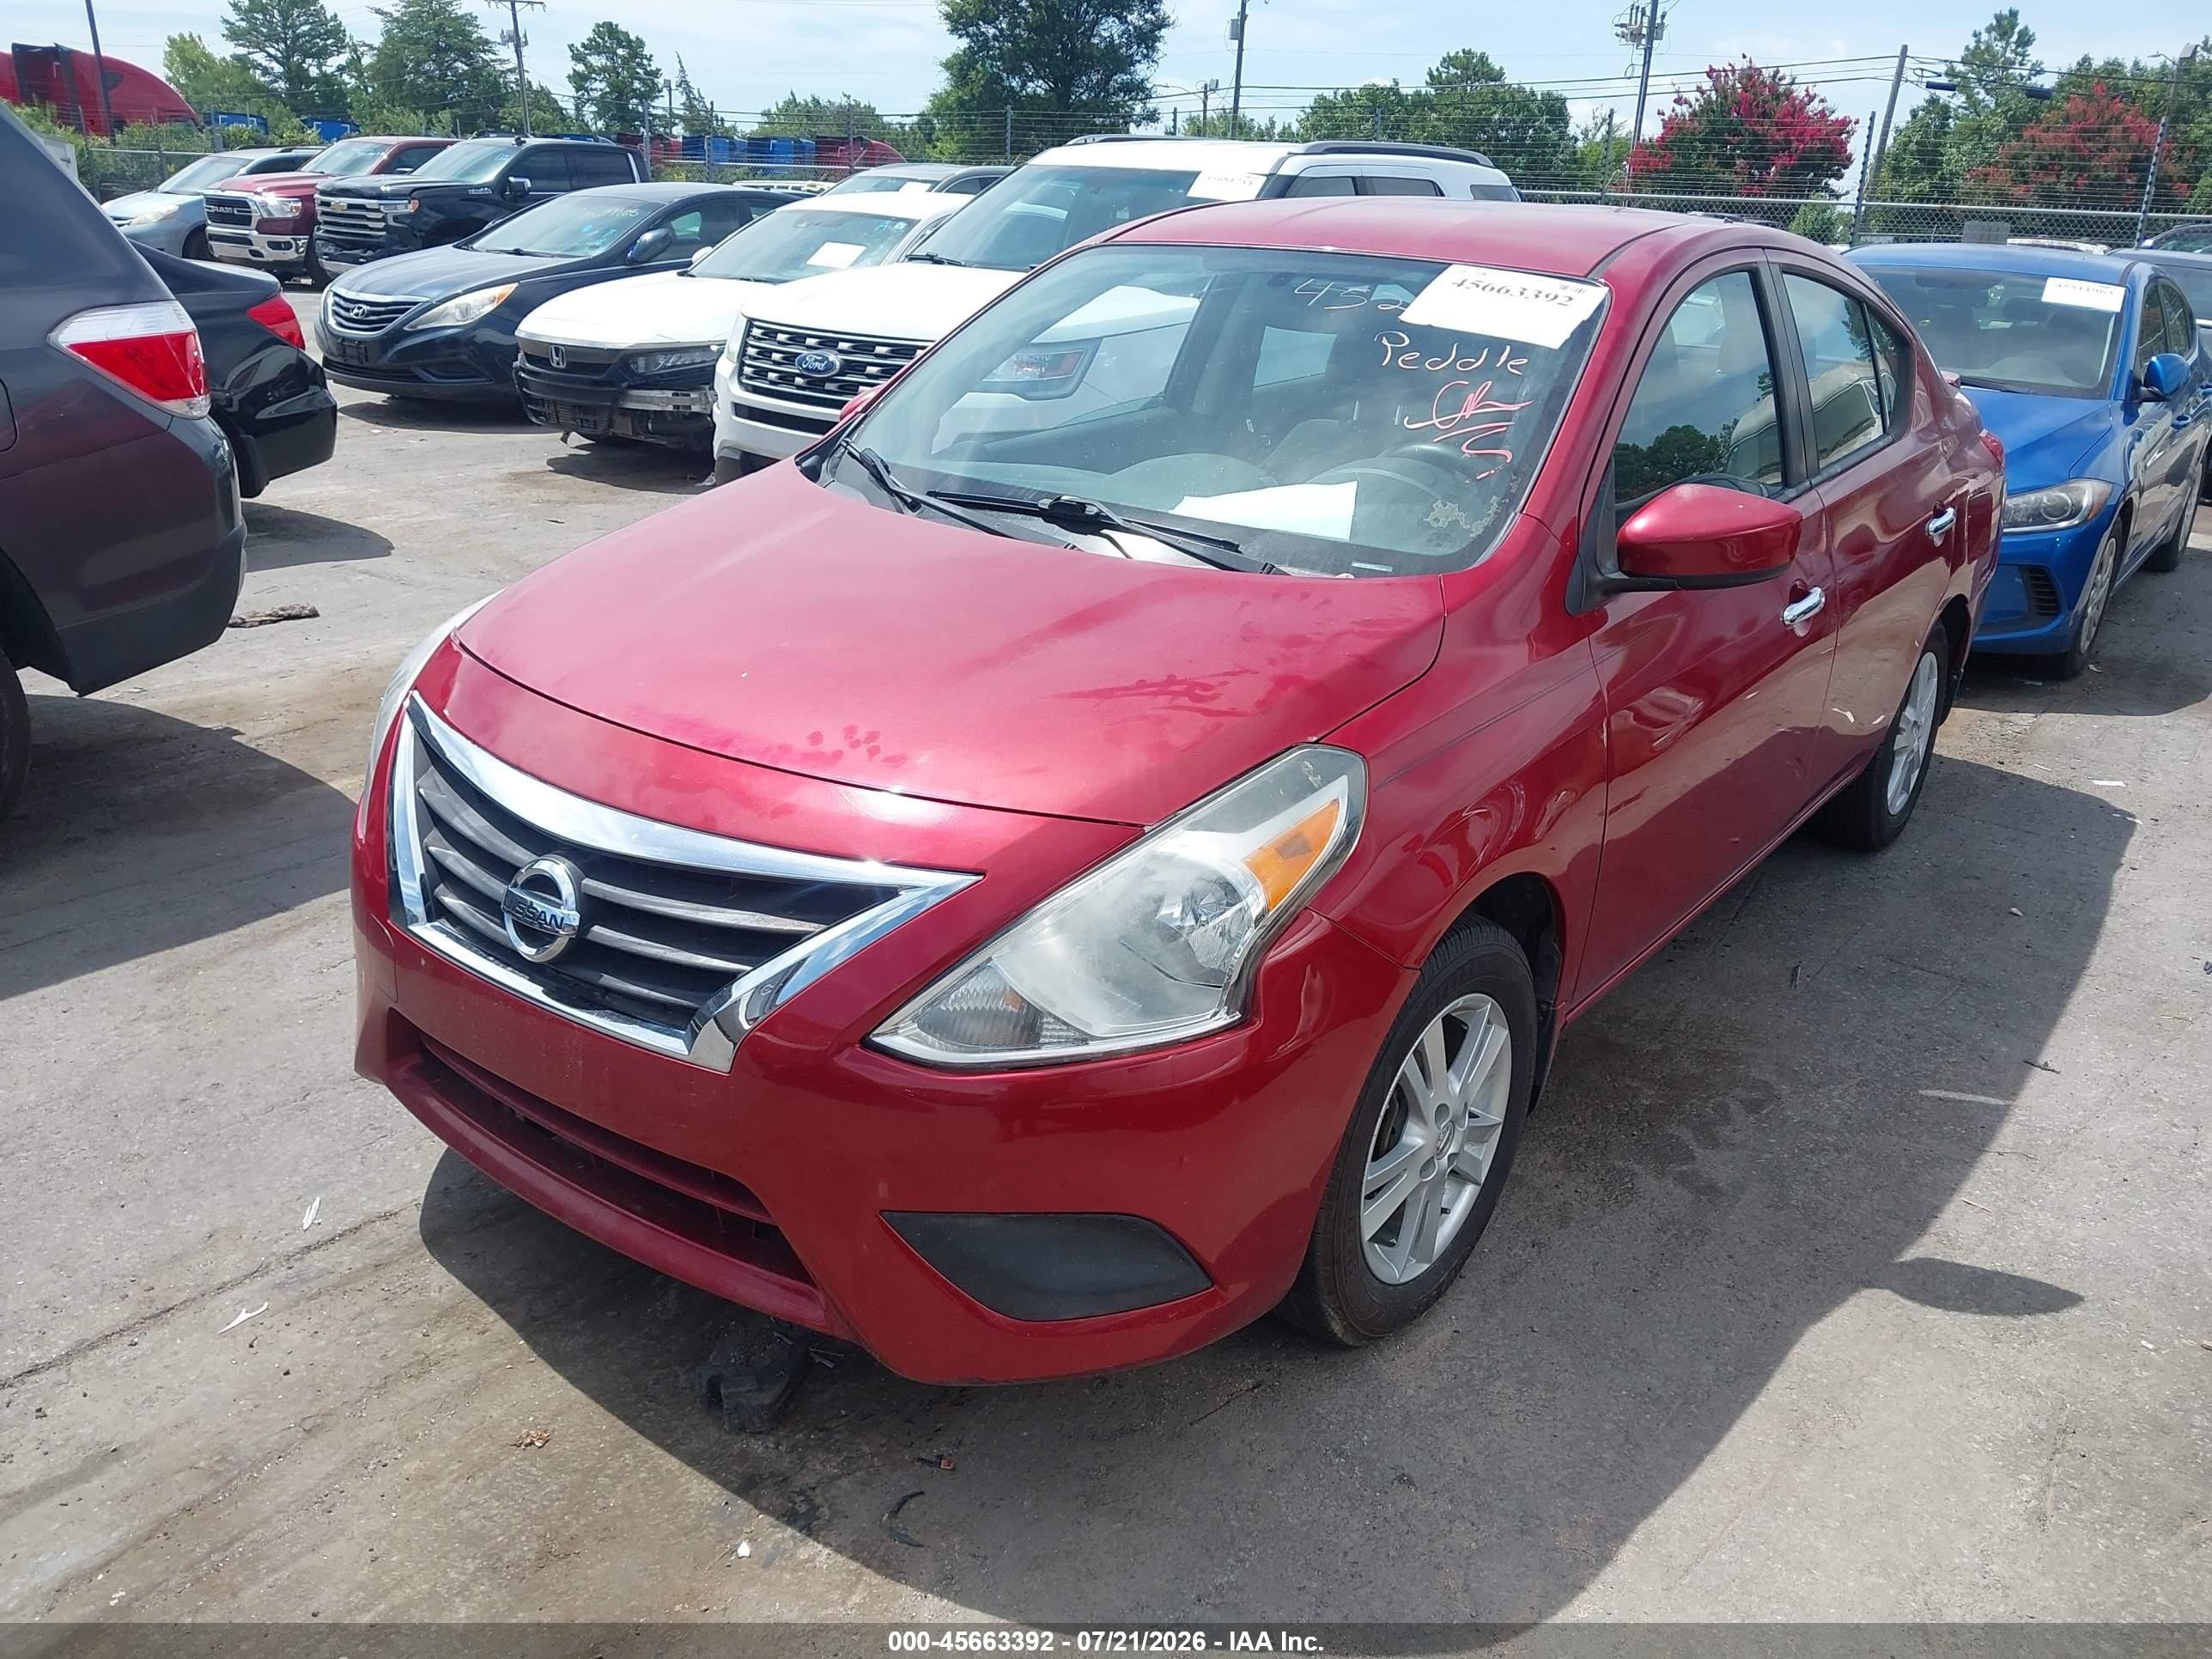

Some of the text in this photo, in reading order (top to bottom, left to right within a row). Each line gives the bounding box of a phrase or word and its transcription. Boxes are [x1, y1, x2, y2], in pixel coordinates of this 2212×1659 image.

[1451, 277, 1574, 307] 45663392
[802, 355, 827, 371] Ford
[1374, 331, 1528, 375] Peddle
[506, 895, 565, 930] SSAN
